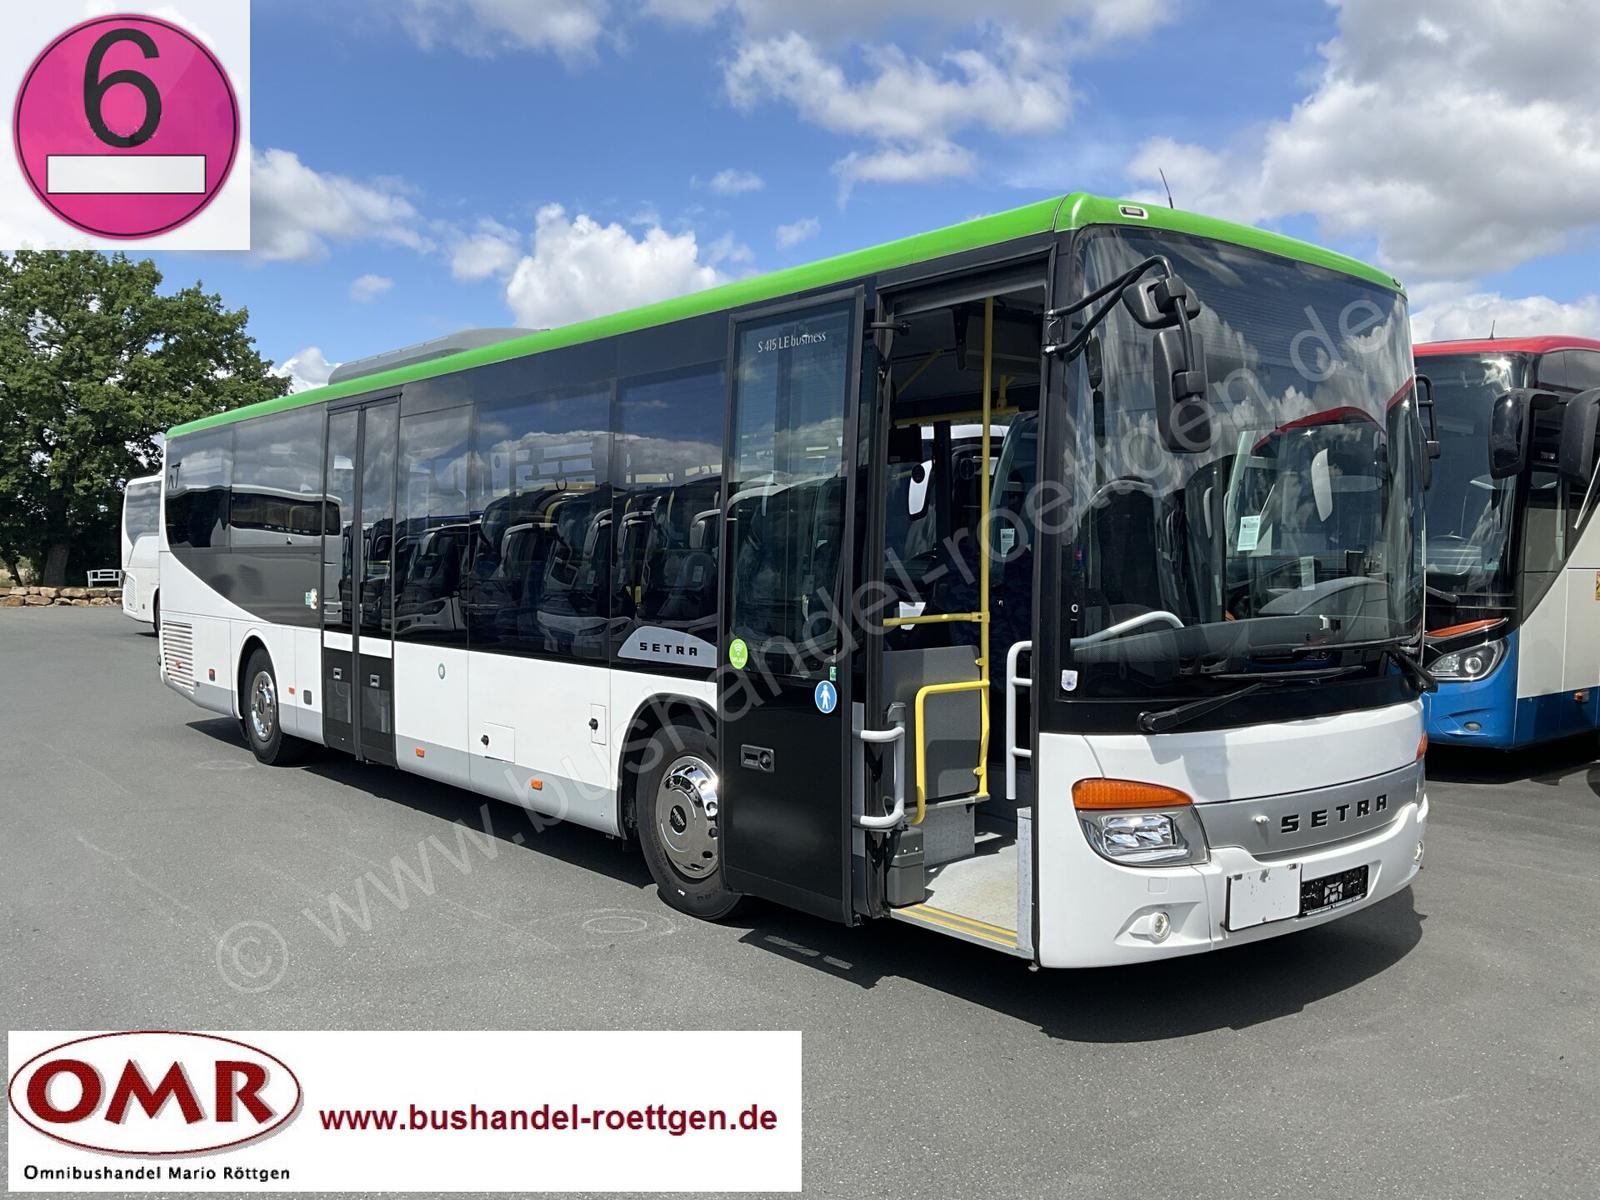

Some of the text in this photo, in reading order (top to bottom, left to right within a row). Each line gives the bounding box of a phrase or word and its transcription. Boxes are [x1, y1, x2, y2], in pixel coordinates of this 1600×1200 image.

[758, 332, 827, 353] S 415 LE business
[639, 642, 698, 656] SETRA
[1281, 794, 1388, 833] SETRA
